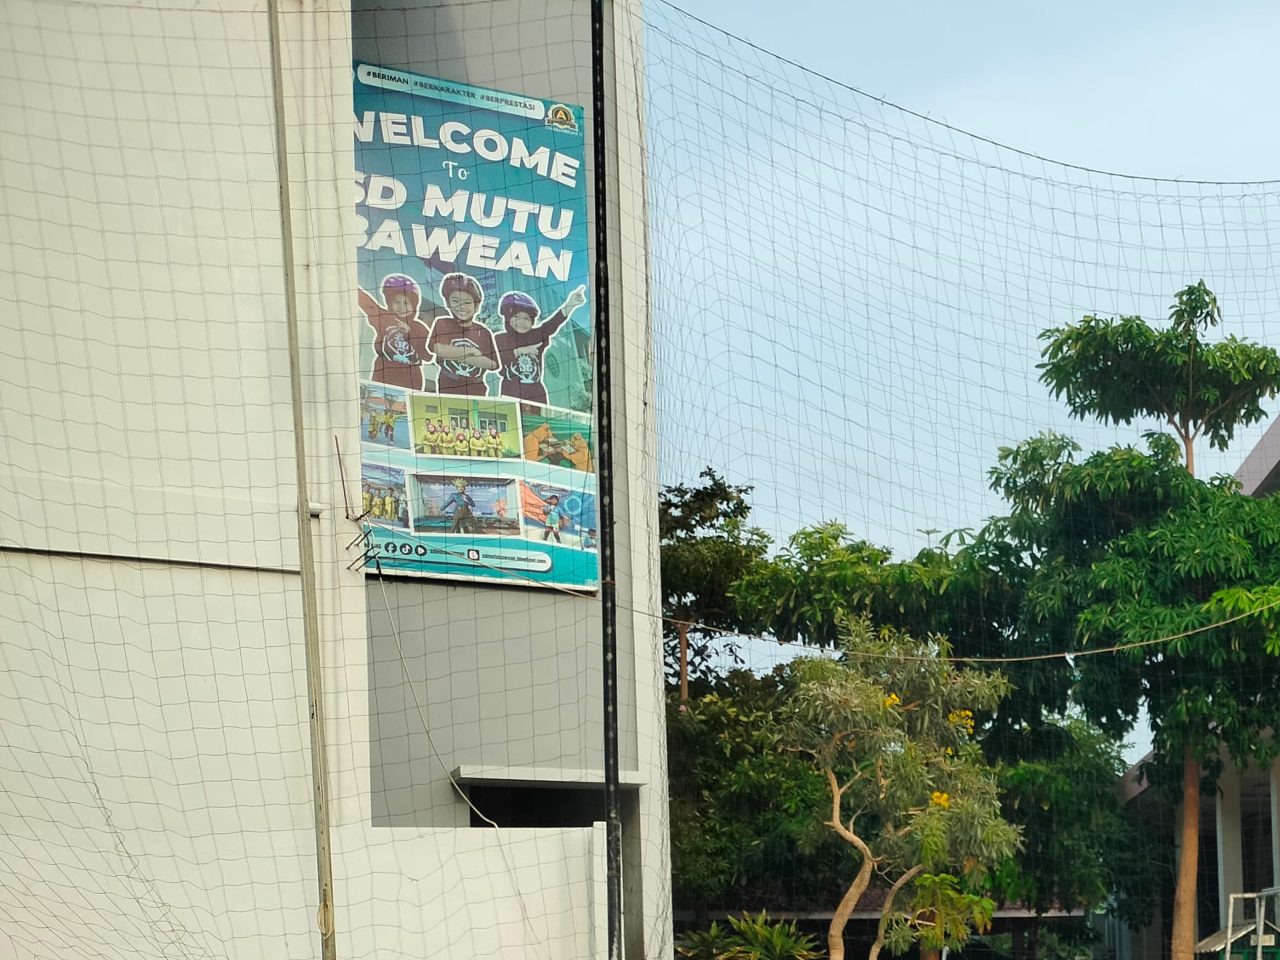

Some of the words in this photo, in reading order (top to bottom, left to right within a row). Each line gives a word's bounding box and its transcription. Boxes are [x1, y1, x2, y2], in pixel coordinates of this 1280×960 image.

[366, 70, 409, 85] #BERIMAN
[413, 81, 476, 99] #BERKARAKTER
[480, 94, 536, 111] #BERPRESTASI
[442, 160, 470, 180] To
[422, 184, 575, 240] MUTU
